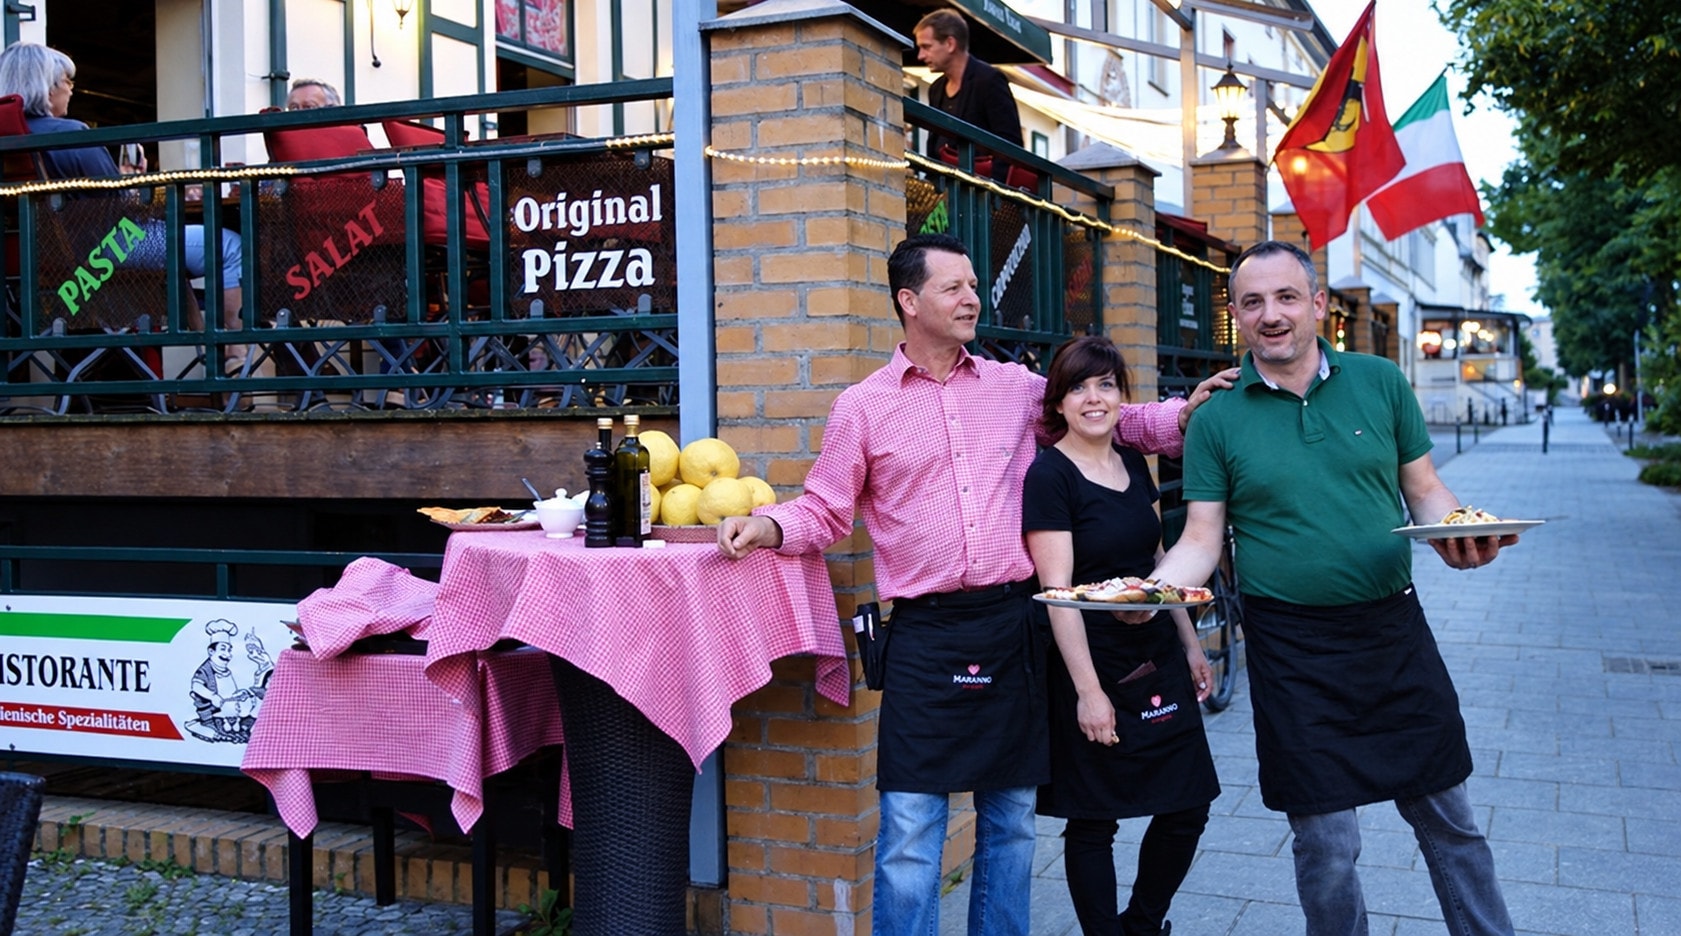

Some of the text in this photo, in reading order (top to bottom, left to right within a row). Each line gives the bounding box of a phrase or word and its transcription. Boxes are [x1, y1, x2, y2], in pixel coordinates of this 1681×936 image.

[514, 184, 663, 237] Original
[57, 216, 147, 316] PASTA
[285, 200, 386, 300] SALAT
[521, 240, 656, 294] Pizza
[58, 709, 151, 732] Spezialitäten
